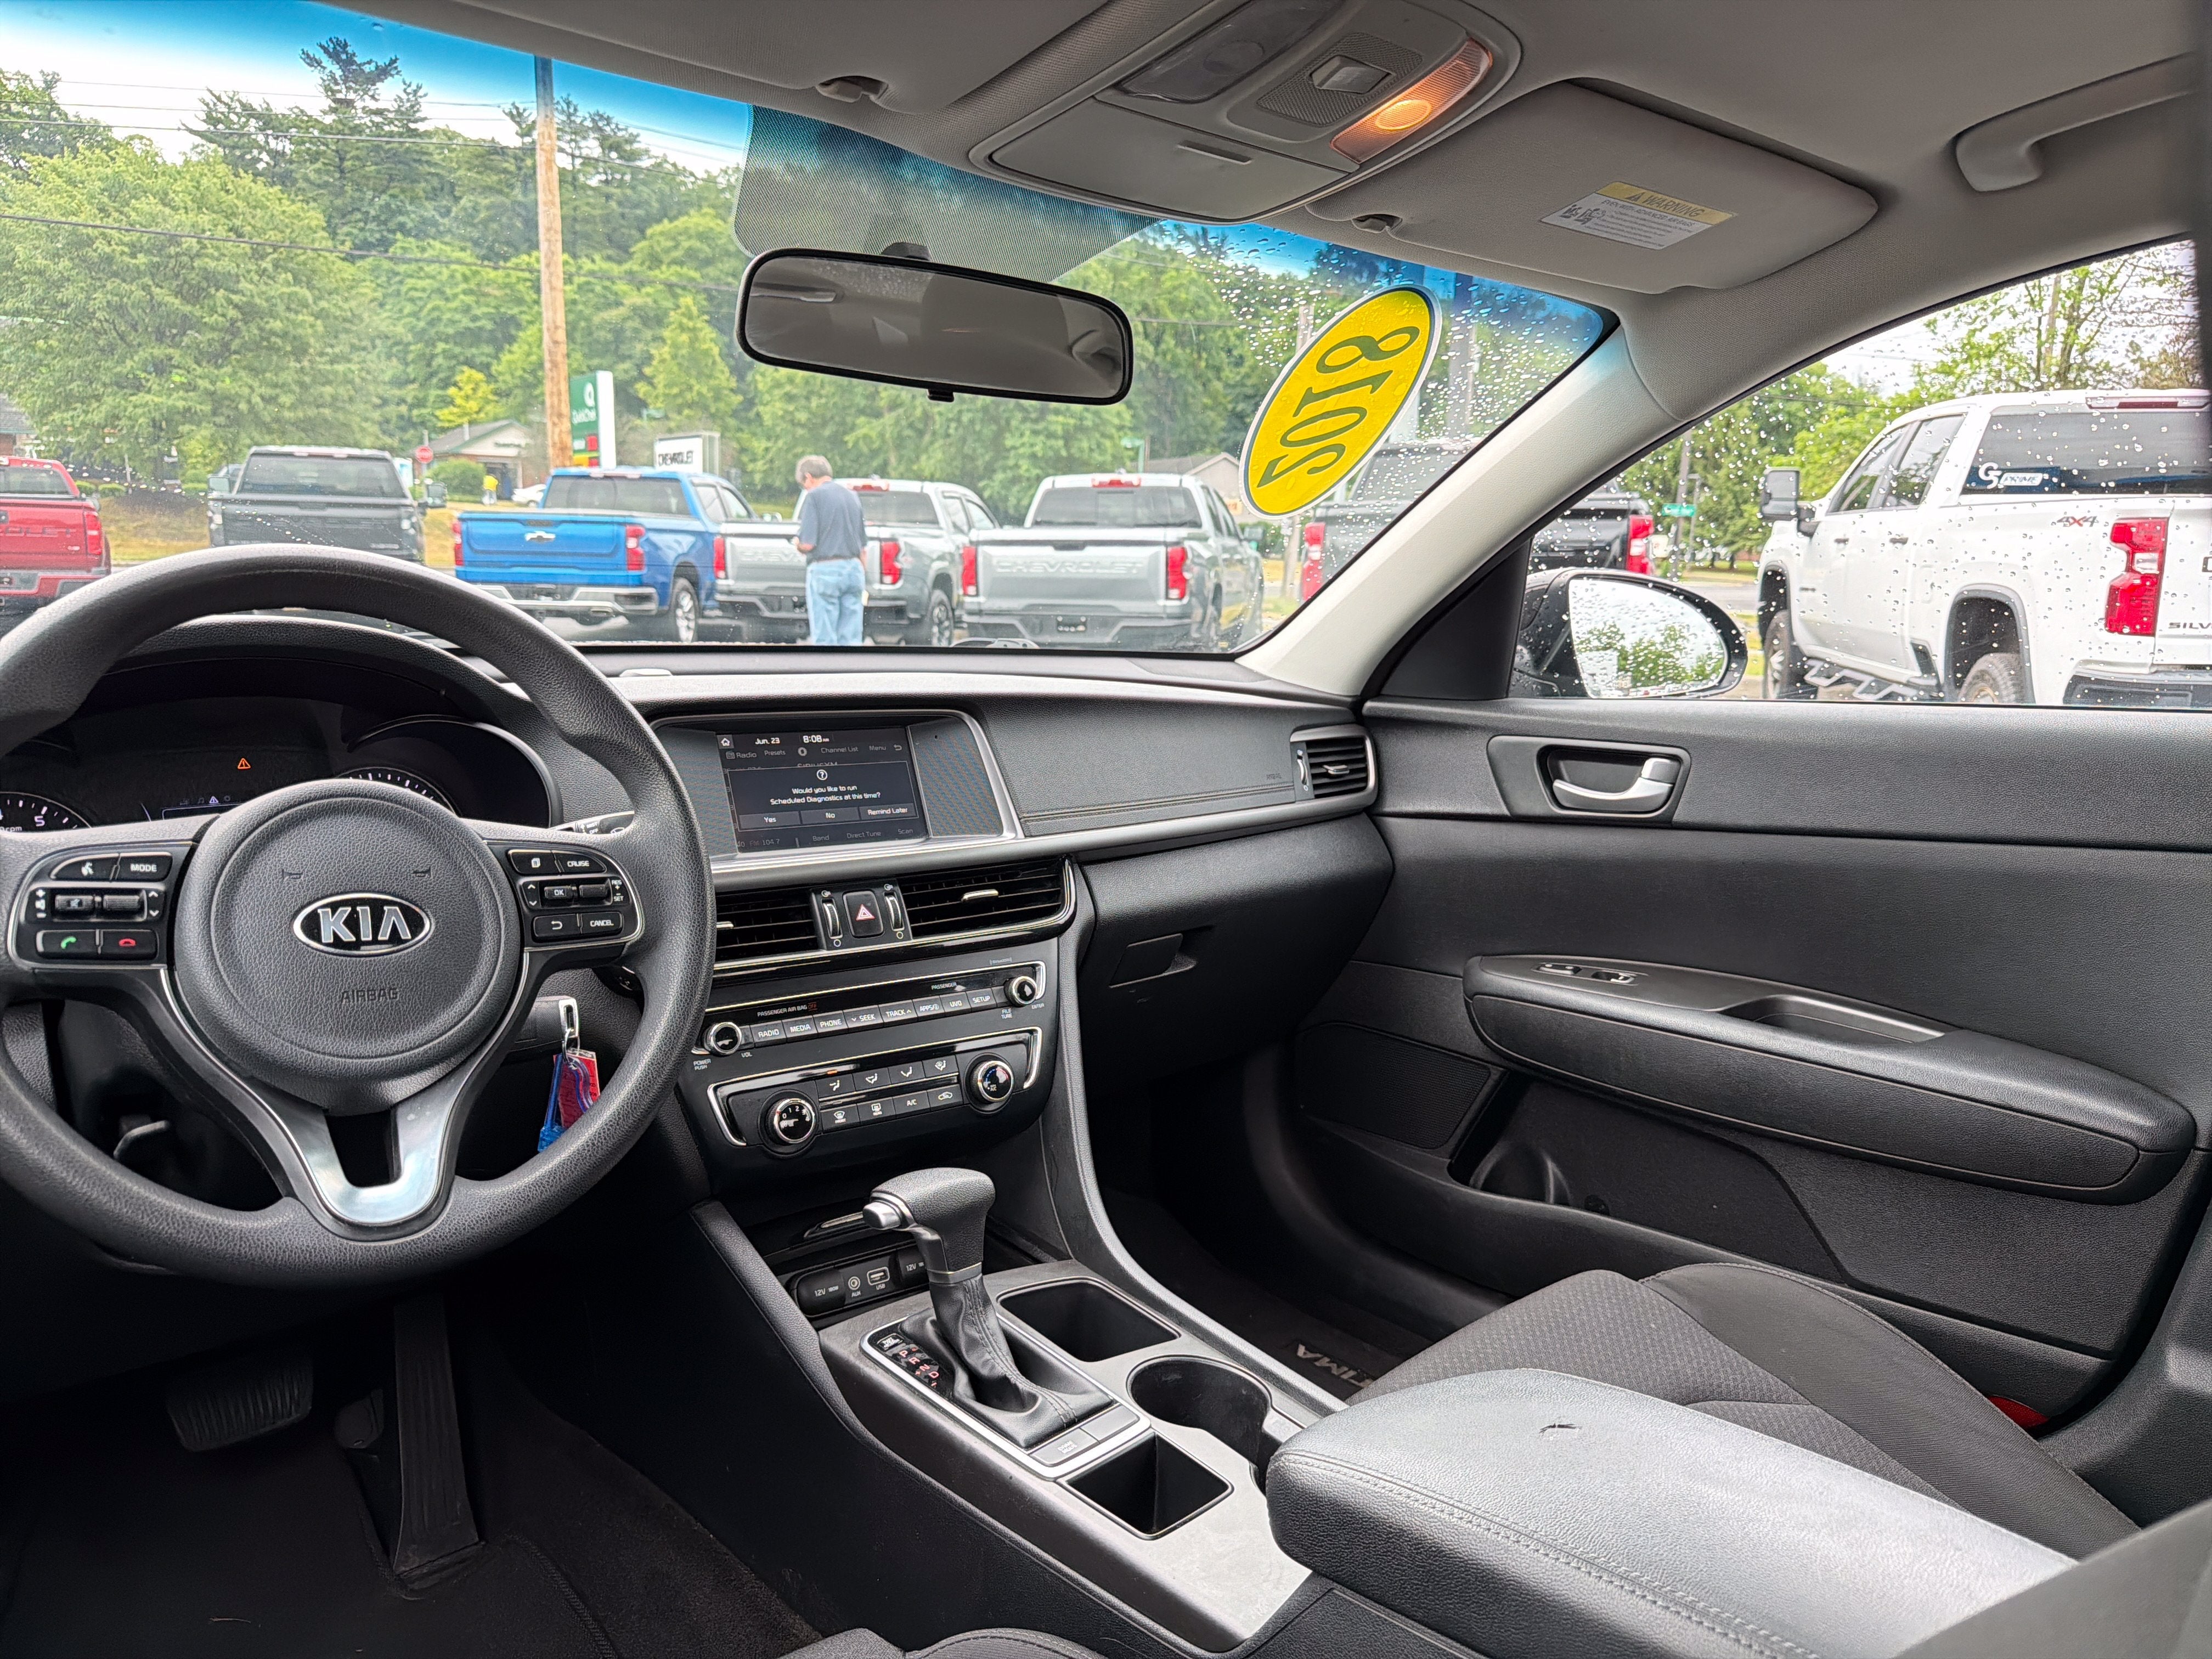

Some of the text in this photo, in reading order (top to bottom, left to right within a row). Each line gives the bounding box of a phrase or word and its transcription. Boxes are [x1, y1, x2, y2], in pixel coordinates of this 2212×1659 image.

[1601, 199, 1620, 207] EVEN
[1643, 194, 1705, 217] WARNING
[0, 526, 78, 538] OLET
[996, 559, 1144, 573] CHEVROLET
[803, 735, 822, 743] 8:08
[770, 797, 806, 805] Scheduled
[131, 864, 157, 872] MODE
[318, 906, 411, 943] KIA
[931, 981, 957, 990] PASSENGER
[341, 988, 399, 1003] AIRBAG
[972, 995, 991, 1004] SETUP
[757, 1008, 787, 1017] PASSENGER
[885, 1009, 906, 1018] TRACK
[859, 1013, 876, 1022] SEEK
[820, 1018, 842, 1028] PHONE
[790, 1024, 811, 1033] MEDIA
[758, 1029, 780, 1038] RADIO
[906, 1263, 916, 1272] 12V
[815, 1288, 826, 1296] 12V
[899, 1350, 908, 1358] P
